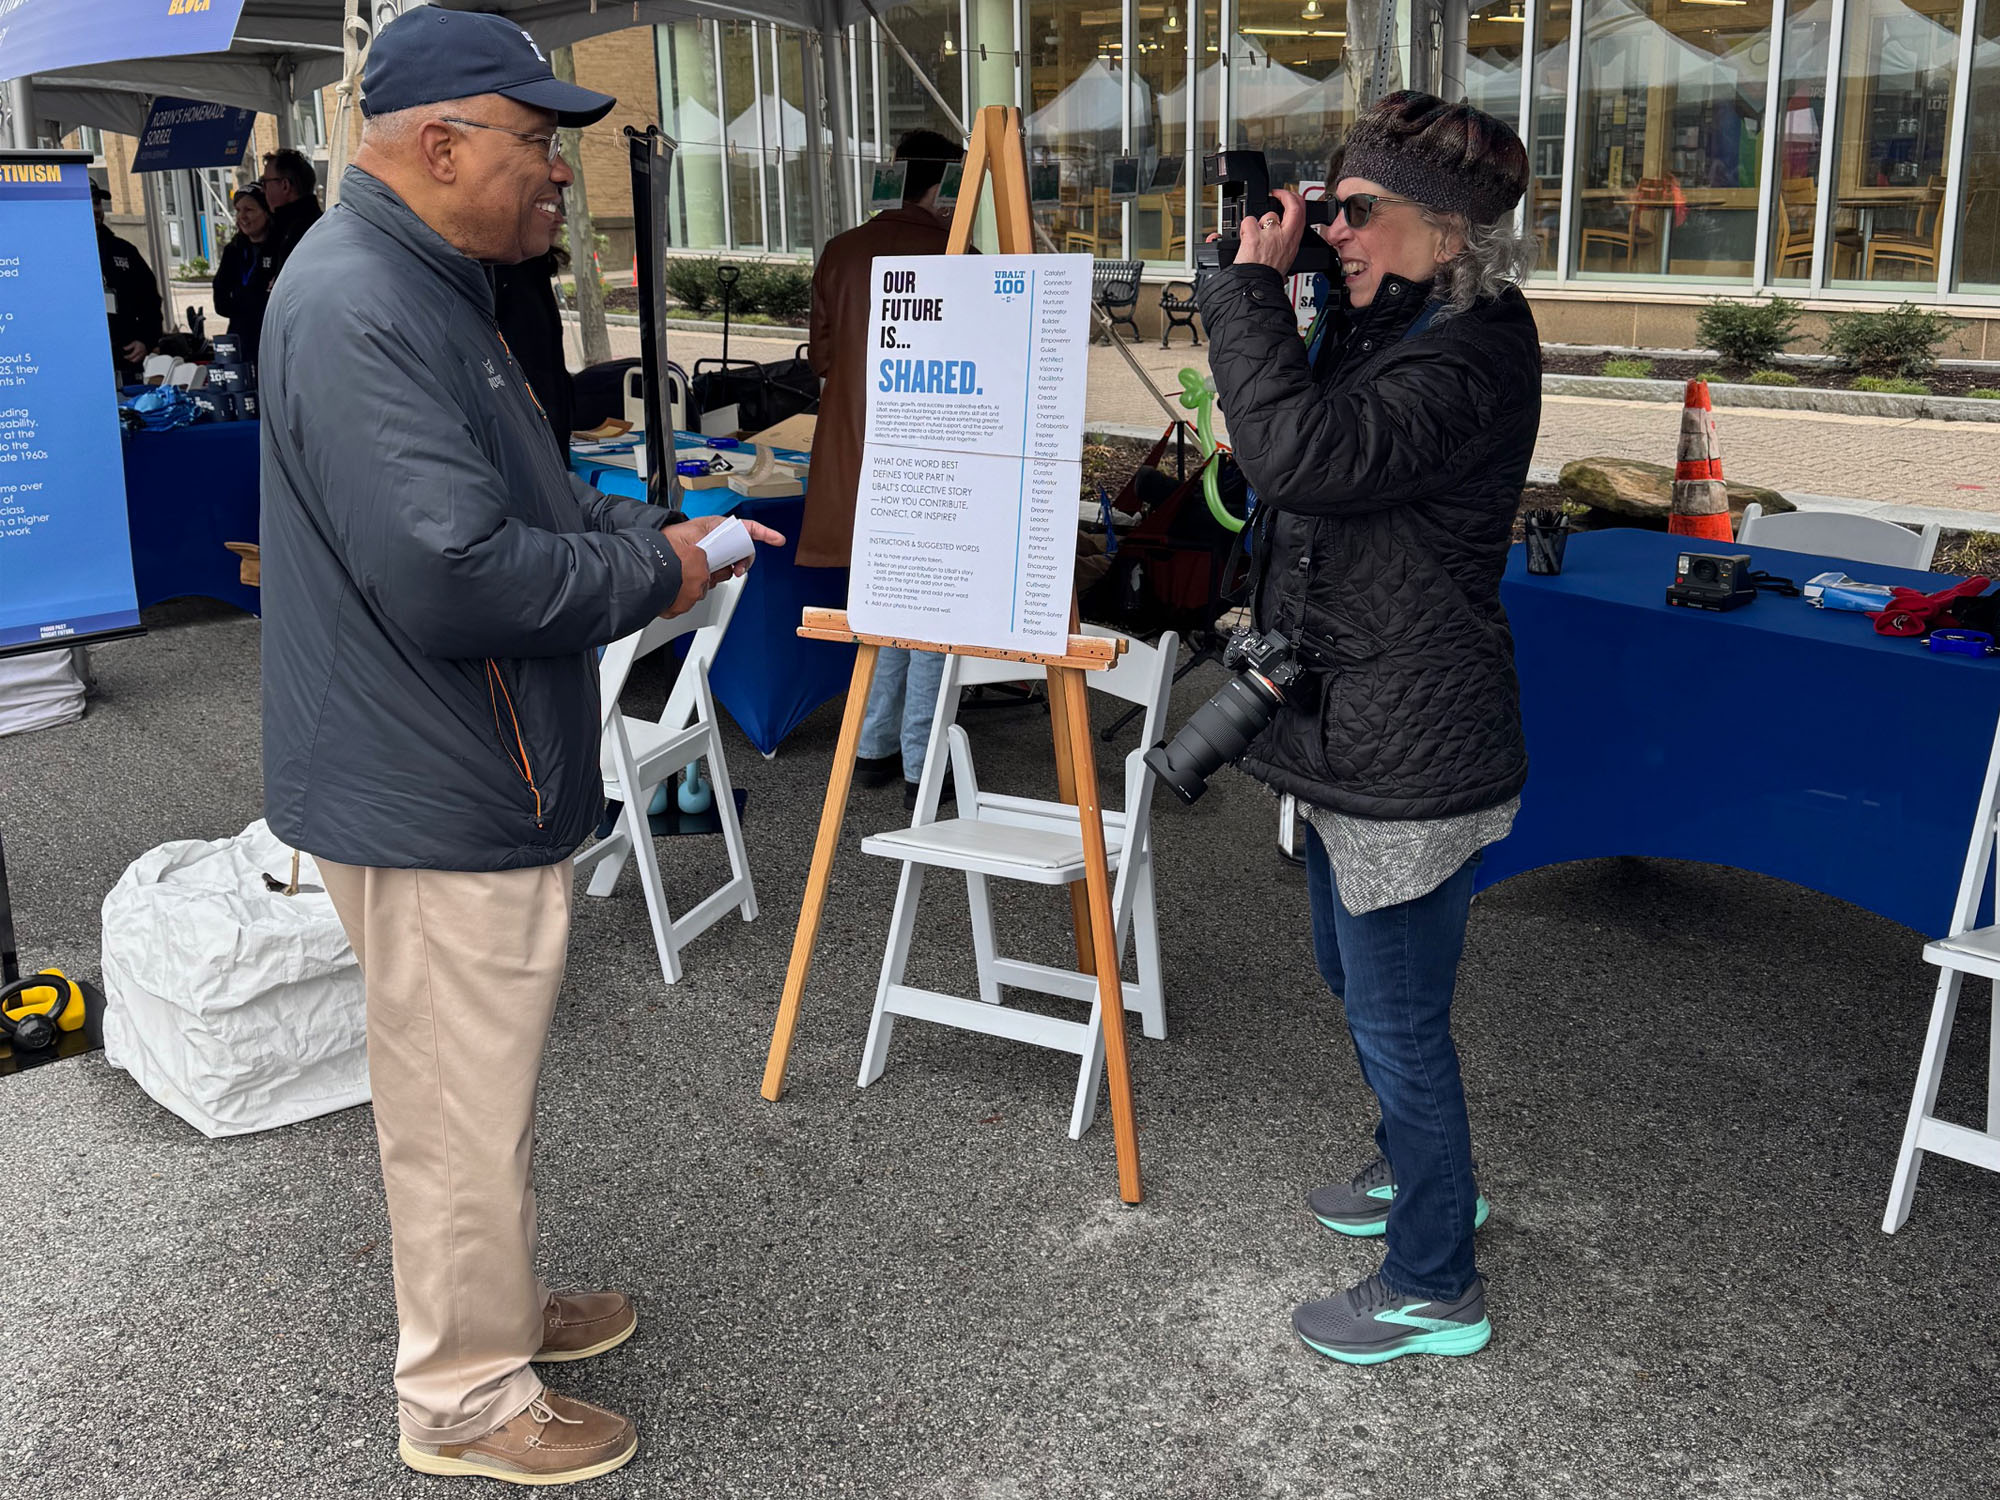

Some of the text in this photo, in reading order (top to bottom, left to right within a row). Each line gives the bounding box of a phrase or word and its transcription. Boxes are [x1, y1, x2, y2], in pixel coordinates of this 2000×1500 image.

[152, 108, 183, 128] ROBYN'S
[182, 104, 226, 122] HOMEMADE
[145, 128, 172, 146] SORREL
[0, 164, 62, 182] TIVISM
[994, 270, 1025, 278] UBALT
[884, 271, 915, 293] OUR
[994, 280, 1024, 294] 100
[882, 298, 943, 321] FUTURE
[880, 326, 910, 348] IS...
[25, 353, 31, 362] 5
[16, 365, 39, 374] they
[16, 376, 25, 385] in
[878, 358, 983, 395] SHARED.
[4, 430, 35, 440] at the
[12, 441, 29, 449] the
[21, 450, 48, 460] 1960s
[896, 458, 912, 467] ONE
[914, 459, 939, 468] WORD
[942, 461, 958, 469] BEST
[873, 470, 901, 479] DEFINES
[903, 472, 923, 480] YOUR
[926, 473, 944, 481] PART
[20, 483, 43, 491] over
[872, 483, 972, 496] UBALT'S COLLECTIVE STORY
[3, 495, 14, 504] of
[881, 496, 968, 510] HOW YOU CONTRIBUTE,
[18, 514, 49, 525] higher
[871, 508, 956, 521] CONNECT, OR INSPIRE?
[6, 527, 31, 536] work
[869, 538, 910, 547] INSTRUCTIONS
[918, 541, 954, 550] SUGGESTED
[1024, 609, 1062, 618] Problem-Solver
